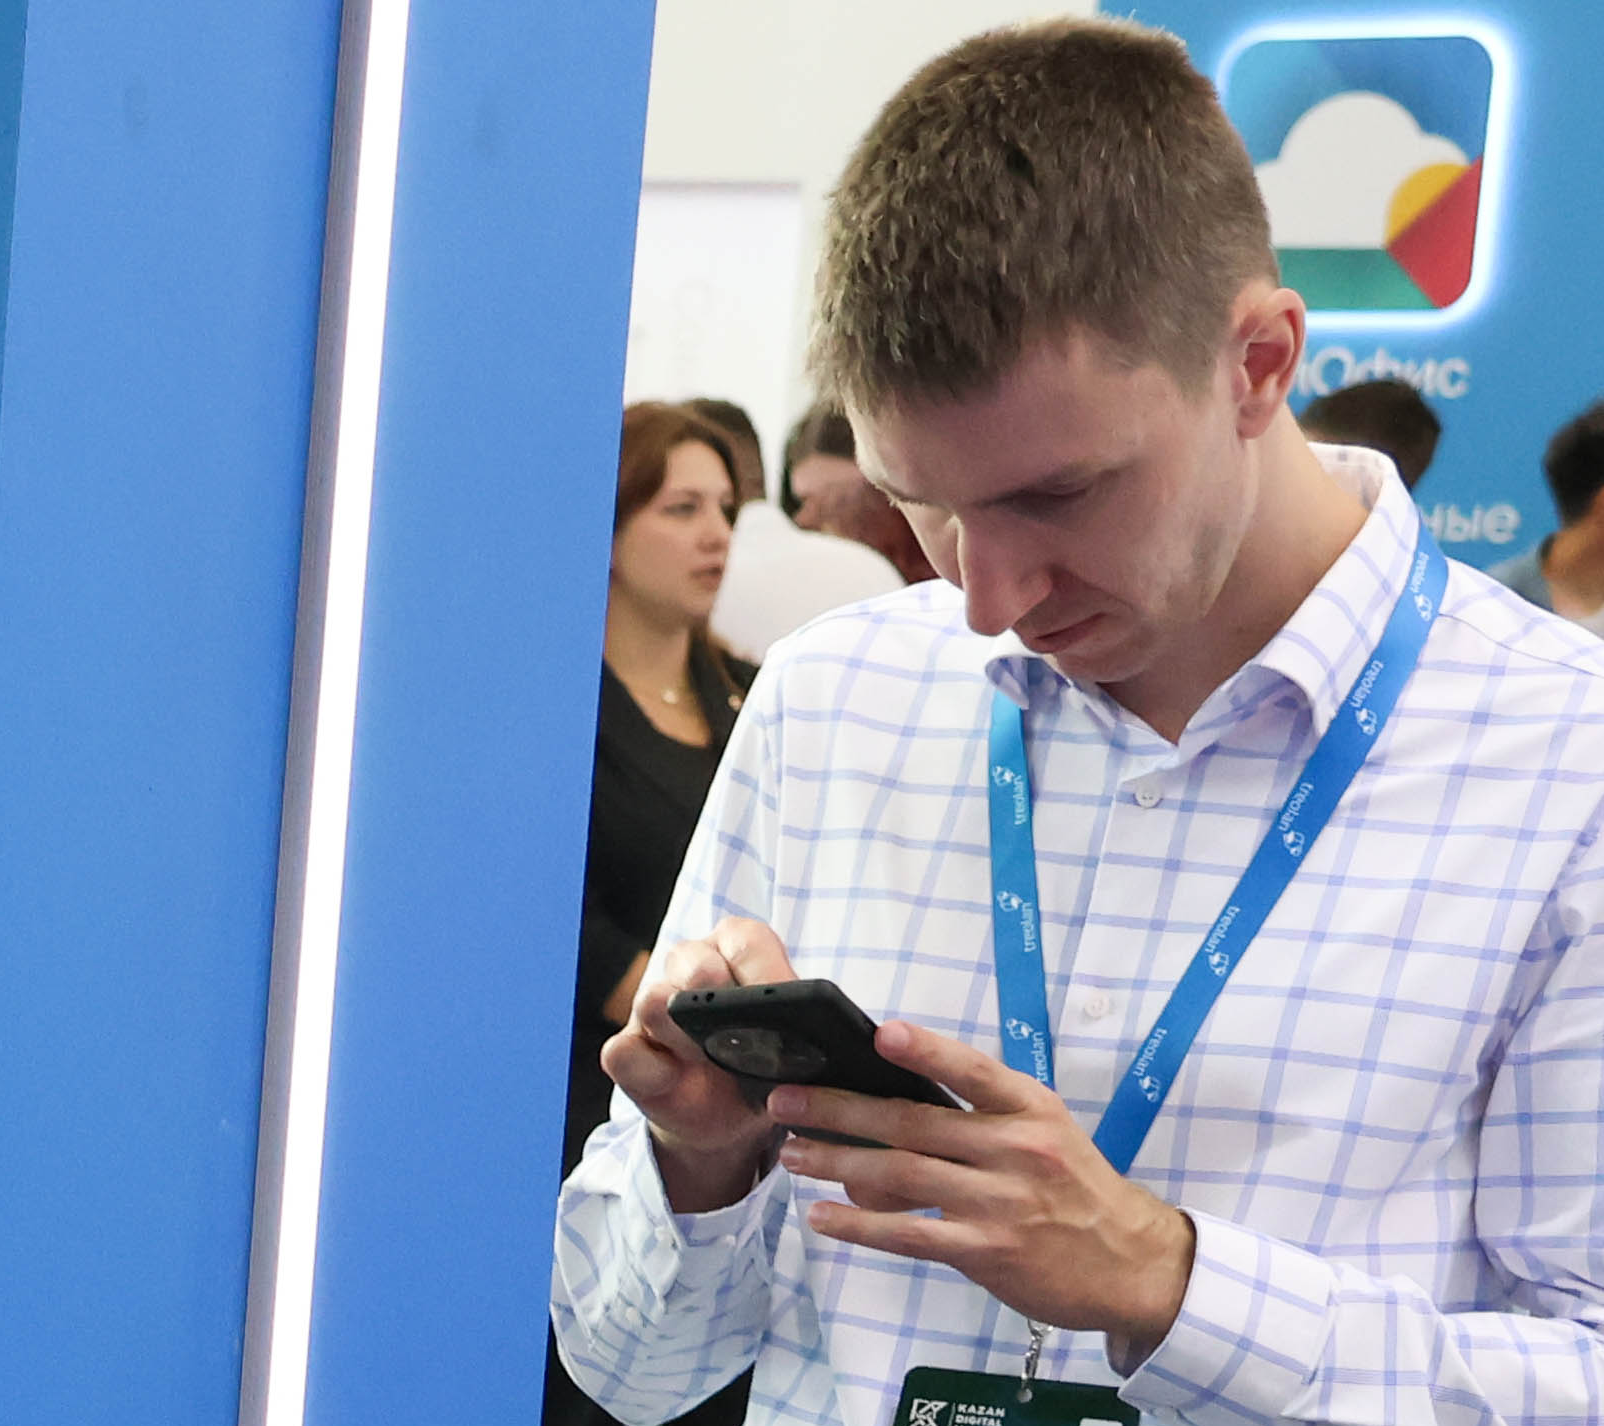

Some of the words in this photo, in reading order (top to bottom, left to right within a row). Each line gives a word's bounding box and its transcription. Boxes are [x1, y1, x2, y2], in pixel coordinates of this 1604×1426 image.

[1351, 658, 1384, 711] treolan
[1277, 780, 1315, 832] treolan
[1022, 901, 1038, 953] treolan
[1203, 904, 1242, 957] treolan
[1131, 1027, 1169, 1079] treolan
[957, 1403, 1006, 1417] KAZAN
